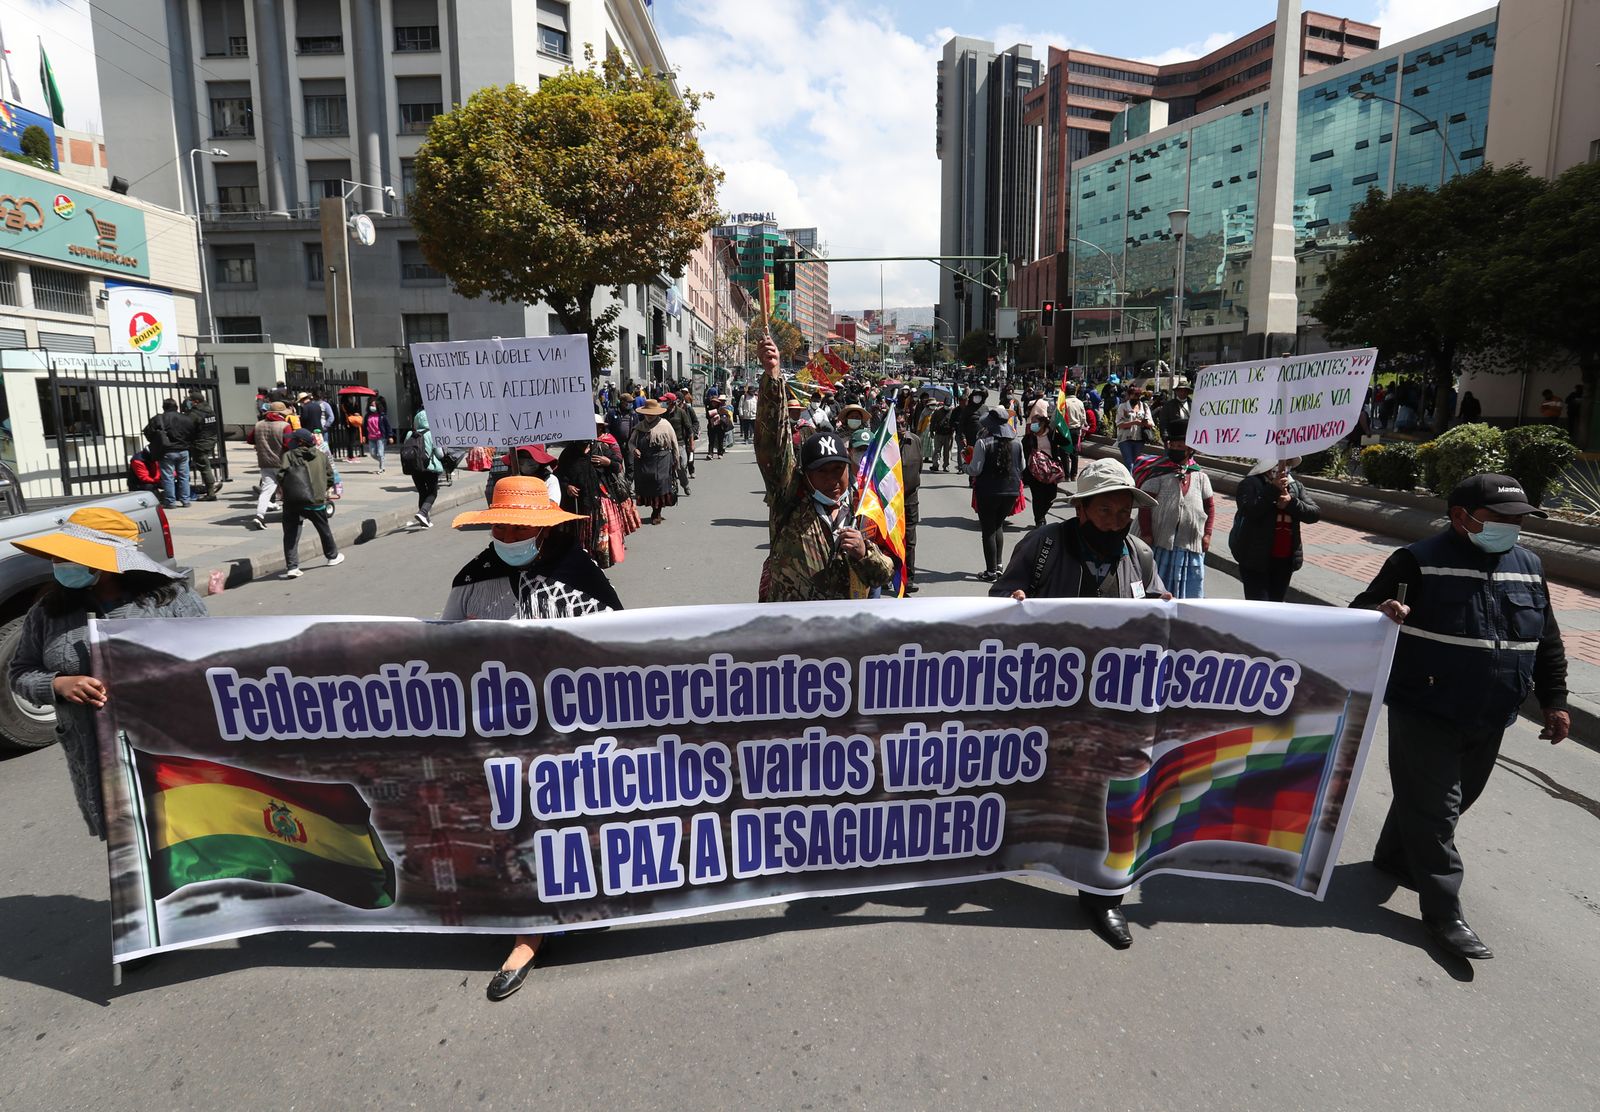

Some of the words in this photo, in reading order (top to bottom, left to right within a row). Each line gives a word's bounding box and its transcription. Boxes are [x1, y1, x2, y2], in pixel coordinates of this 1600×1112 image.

[68, 244, 138, 268] SUPERMERCADO
[133, 325, 160, 345] BOLIVIA
[51, 356, 106, 368] VENTANILLA
[107, 356, 133, 367] ÚNICA
[475, 350, 489, 365] LA
[426, 382, 475, 401] BASTA
[480, 381, 496, 399] DE
[502, 376, 586, 399] ACCIDENTES
[1200, 369, 1238, 390] BASTA
[1247, 366, 1265, 384] DE
[1199, 397, 1259, 417] EXIGIMOS
[1267, 398, 1284, 416] LA
[1289, 391, 1323, 414] DOBLE
[1331, 388, 1351, 406] VIA
[434, 436, 450, 446] RIO
[455, 436, 479, 446] SECO
[487, 437, 494, 446] A
[502, 432, 563, 446] DESAGUADERO
[1193, 429, 1208, 445] LA
[1216, 428, 1240, 444] PAZ
[1265, 420, 1345, 446] DESAGUADERO
[818, 435, 838, 456] NY
[209, 662, 464, 738] Federación
[474, 664, 535, 735] de
[548, 657, 848, 728] comerciantes
[863, 643, 1082, 713] minoristas
[1094, 648, 1296, 711] artesanos
[488, 760, 518, 827] y
[535, 737, 728, 818] artículos
[743, 729, 872, 796] varios
[884, 723, 1046, 792] viajeros
[539, 831, 593, 899] LA
[605, 820, 681, 893] PAZ
[693, 816, 725, 881] A
[735, 796, 1003, 876] DESAGUADERO
